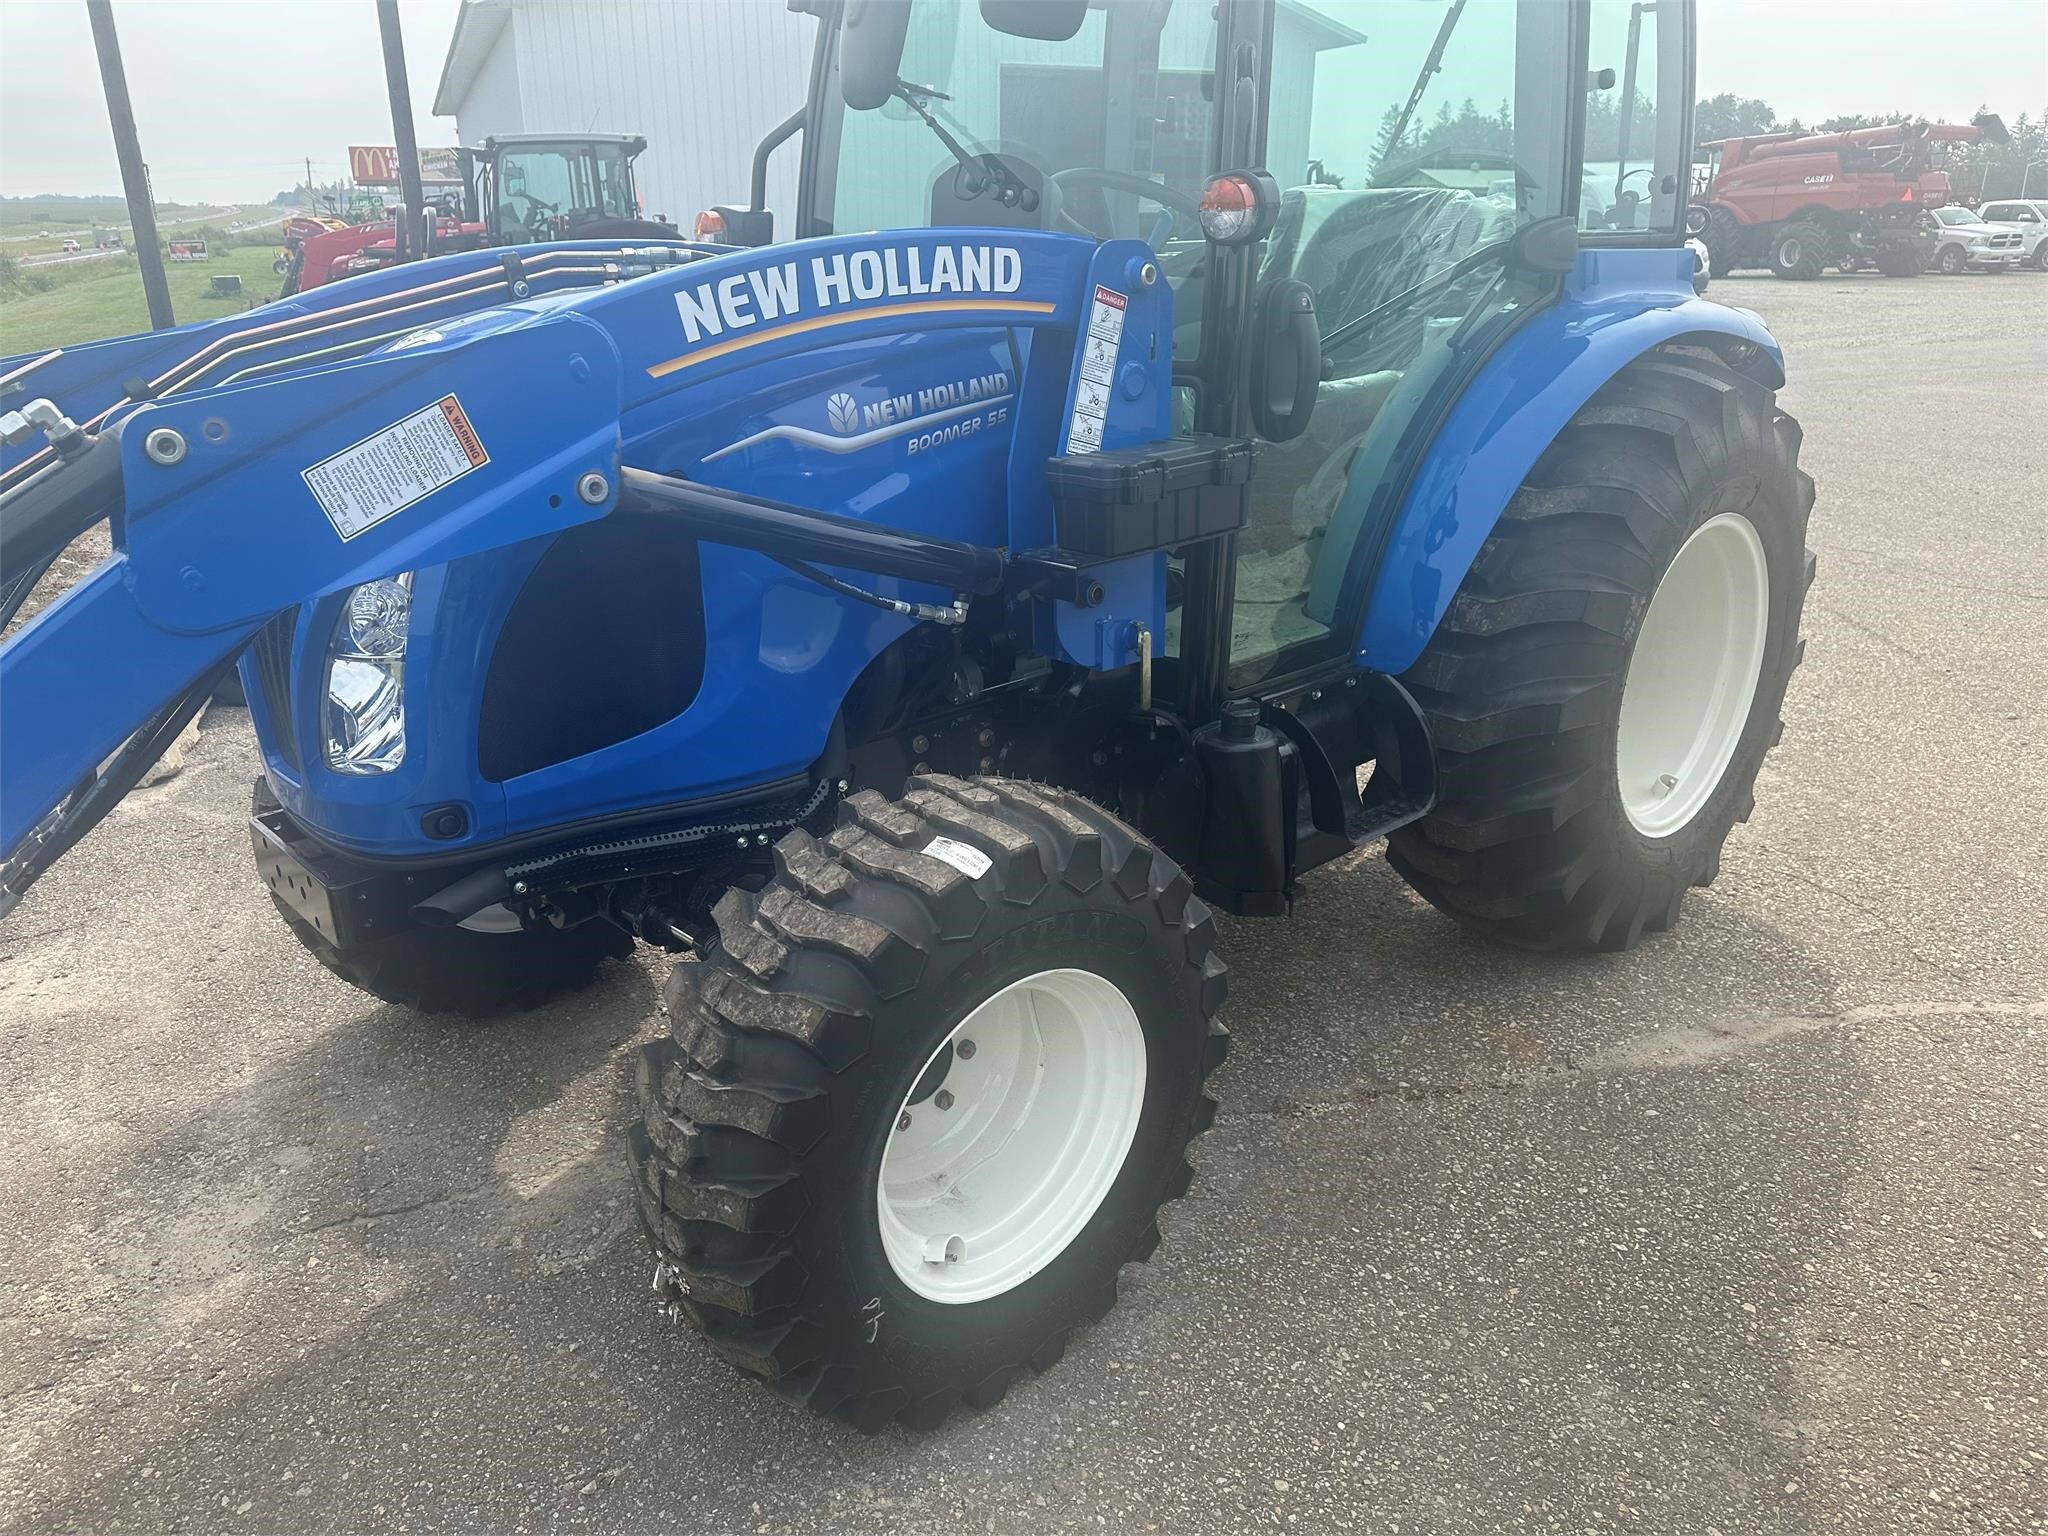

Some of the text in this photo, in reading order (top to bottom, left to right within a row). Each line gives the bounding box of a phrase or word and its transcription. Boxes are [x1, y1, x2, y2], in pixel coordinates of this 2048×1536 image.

[674, 245, 1023, 343] NEW HOLLAND
[1102, 293, 1125, 307] DANGER
[863, 373, 1009, 429] NEW HOLLAND
[437, 413, 466, 461] LOADER SAFETY
[451, 415, 480, 459] WARNING
[906, 407, 1008, 456] BOOMER 55
[389, 431, 426, 490] INSTALLING LOADER
[400, 436, 428, 478] REMOVING OR
